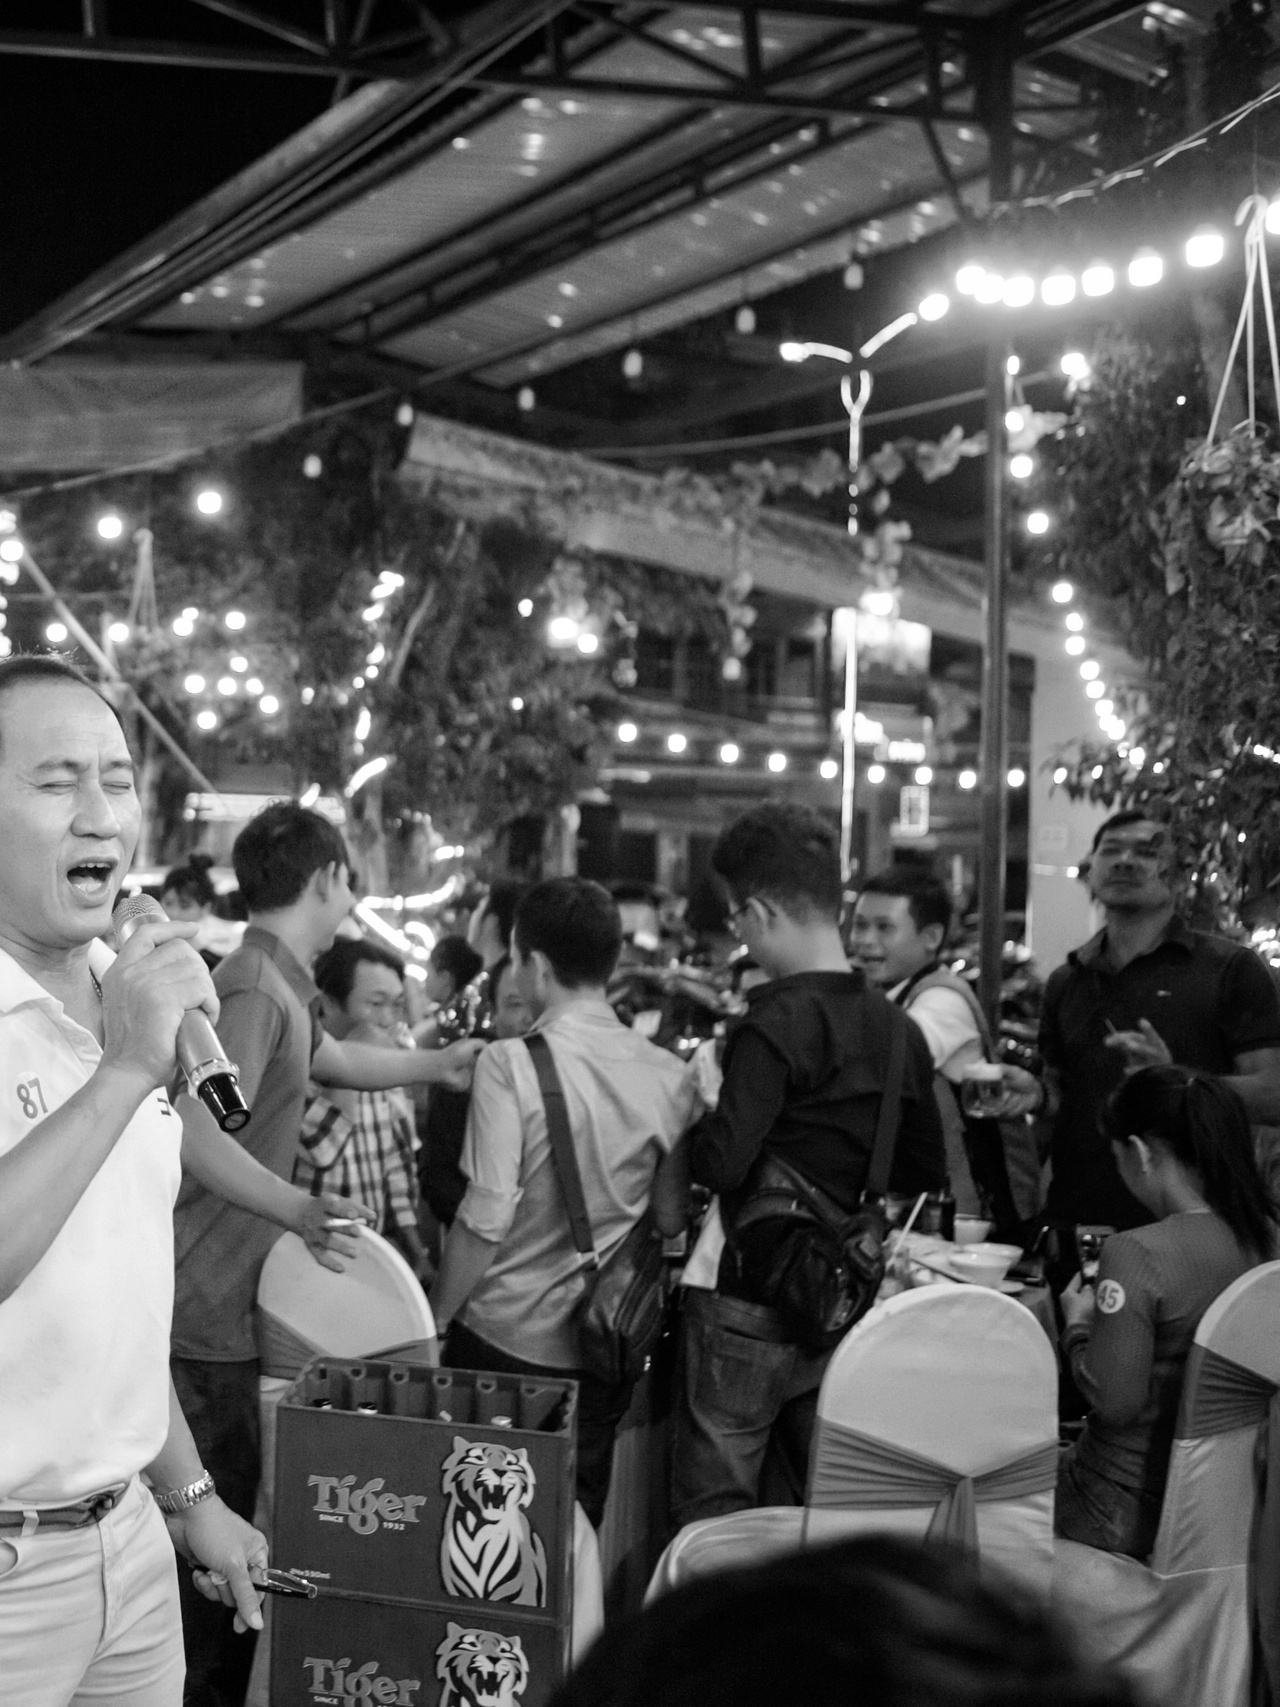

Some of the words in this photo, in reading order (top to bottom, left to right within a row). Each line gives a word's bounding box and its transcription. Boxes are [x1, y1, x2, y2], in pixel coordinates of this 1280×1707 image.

[17, 1077, 49, 1119] 87
[1099, 1285, 1119, 1309] 45
[307, 1474, 427, 1535] Tiger
[382, 1521, 405, 1531] 1932
[302, 1656, 421, 1707] Tiger
